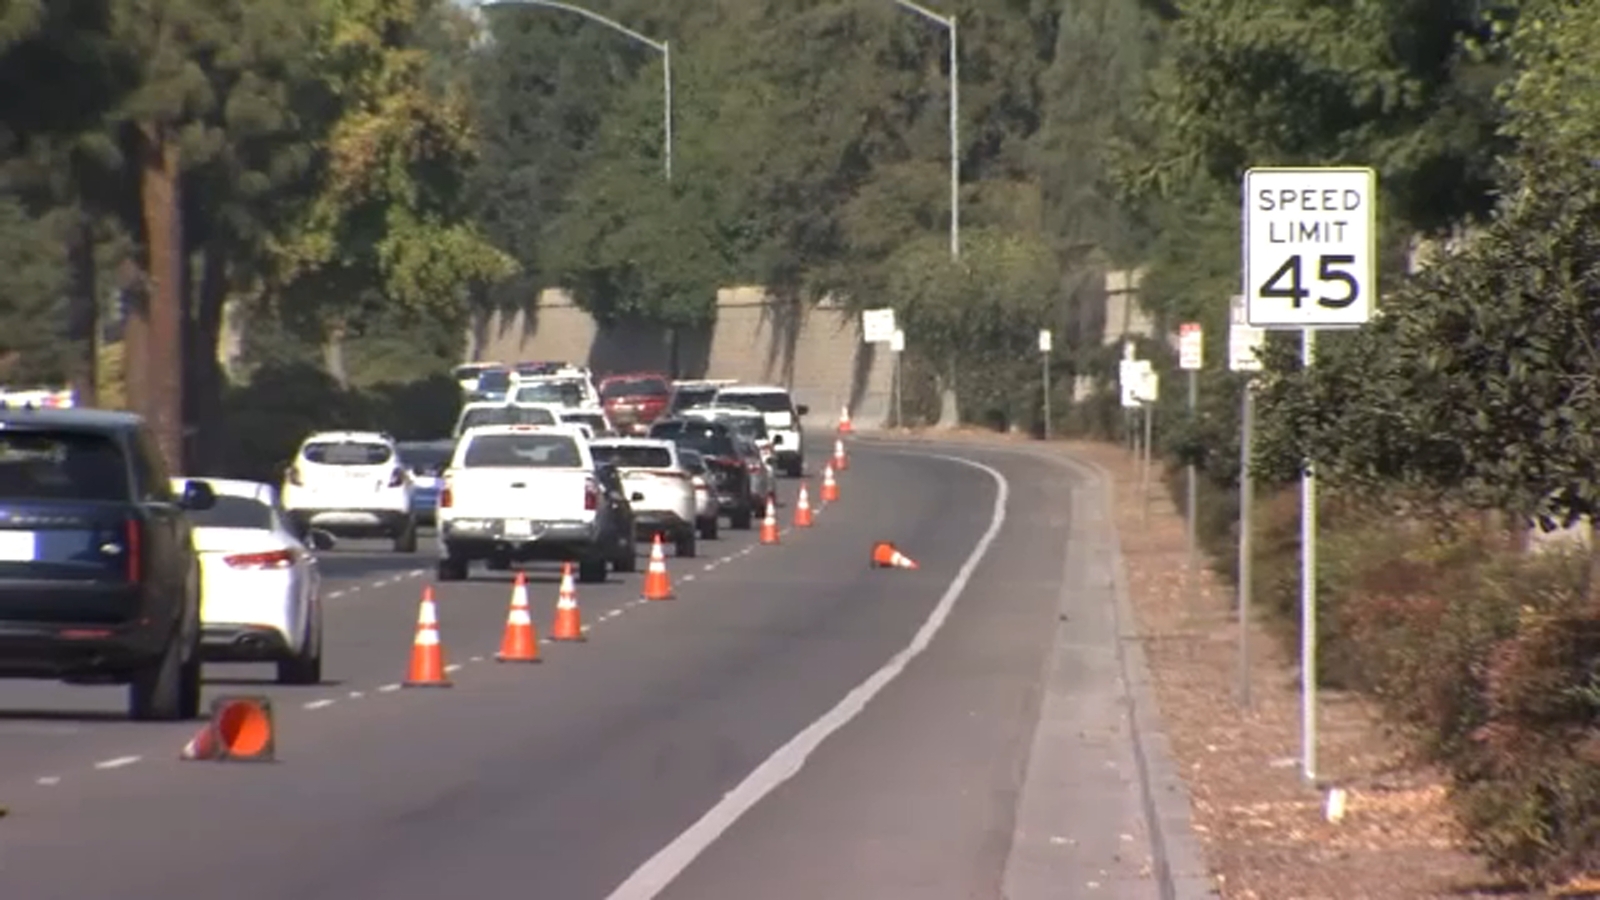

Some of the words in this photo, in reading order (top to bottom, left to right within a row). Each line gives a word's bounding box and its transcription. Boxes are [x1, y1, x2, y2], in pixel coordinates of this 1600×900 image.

[1259, 189, 1361, 211] SPEED
[1269, 221, 1348, 243] LIMIT
[1259, 254, 1360, 309] 45
